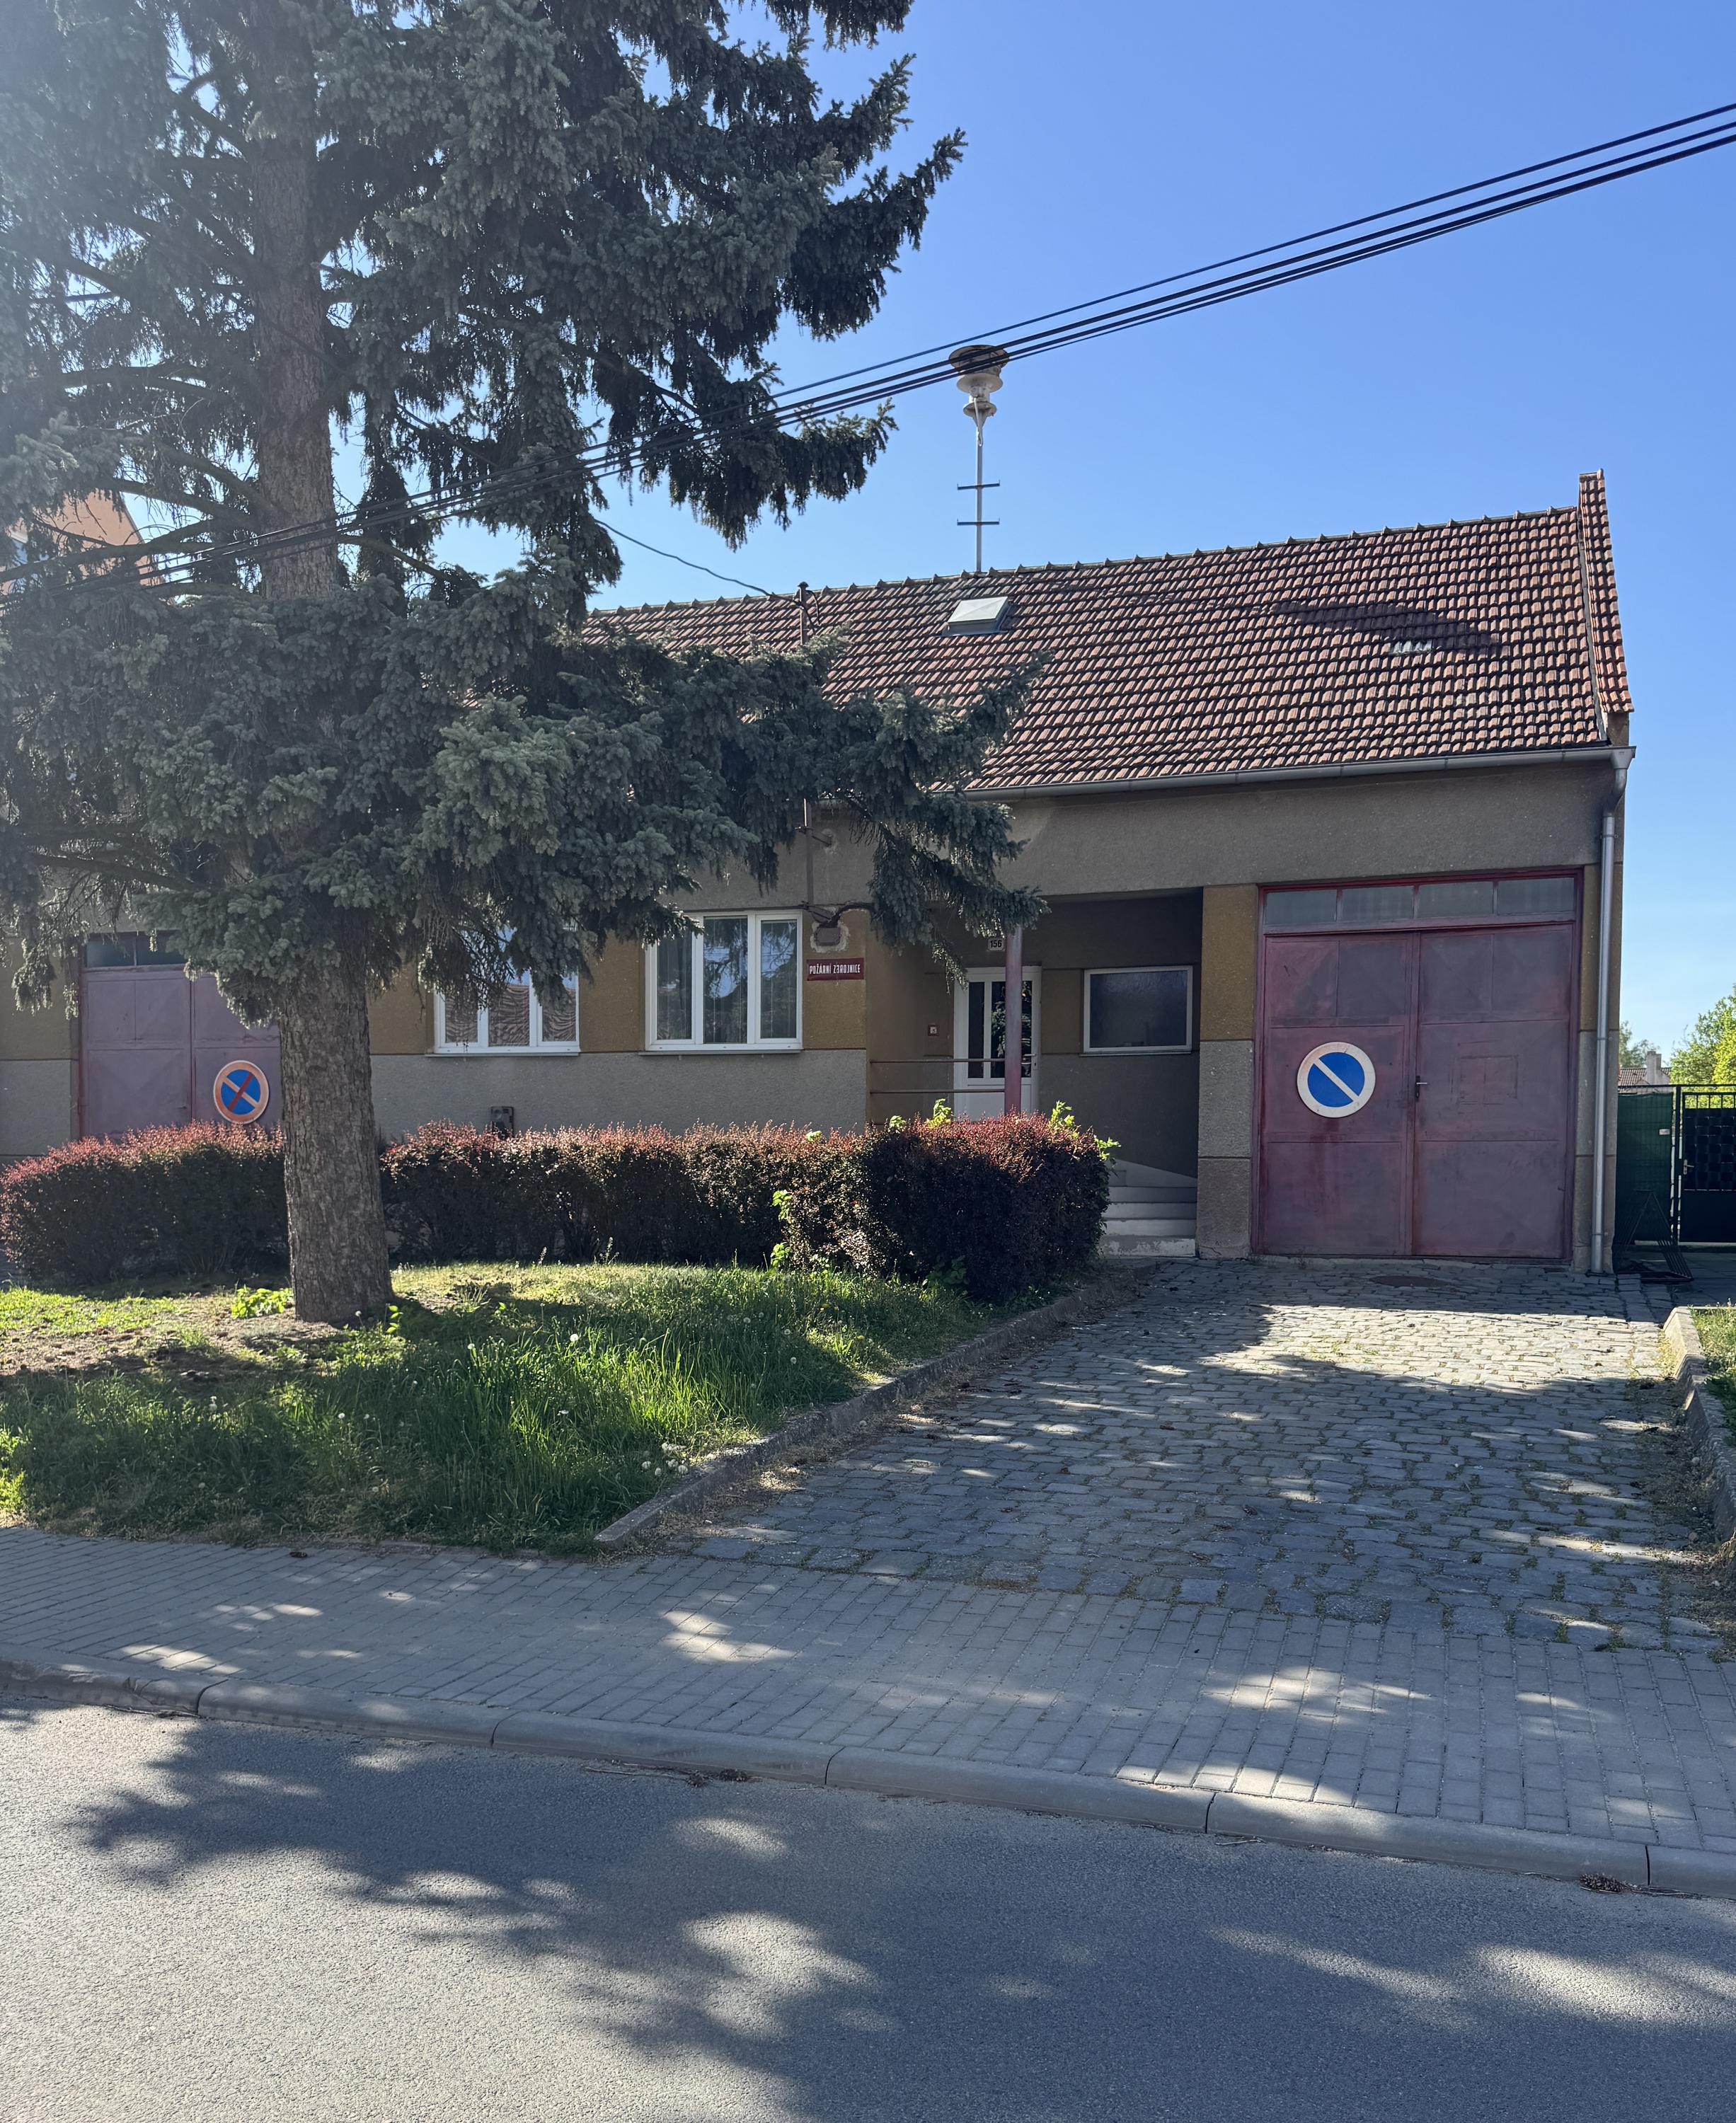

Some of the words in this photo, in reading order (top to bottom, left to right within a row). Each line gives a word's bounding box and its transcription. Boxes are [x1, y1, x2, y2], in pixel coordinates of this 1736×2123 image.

[990, 940, 1002, 948] 156
[809, 963, 832, 974] POŽÁRNÍ
[833, 964, 861, 974] ZBROJNICE
